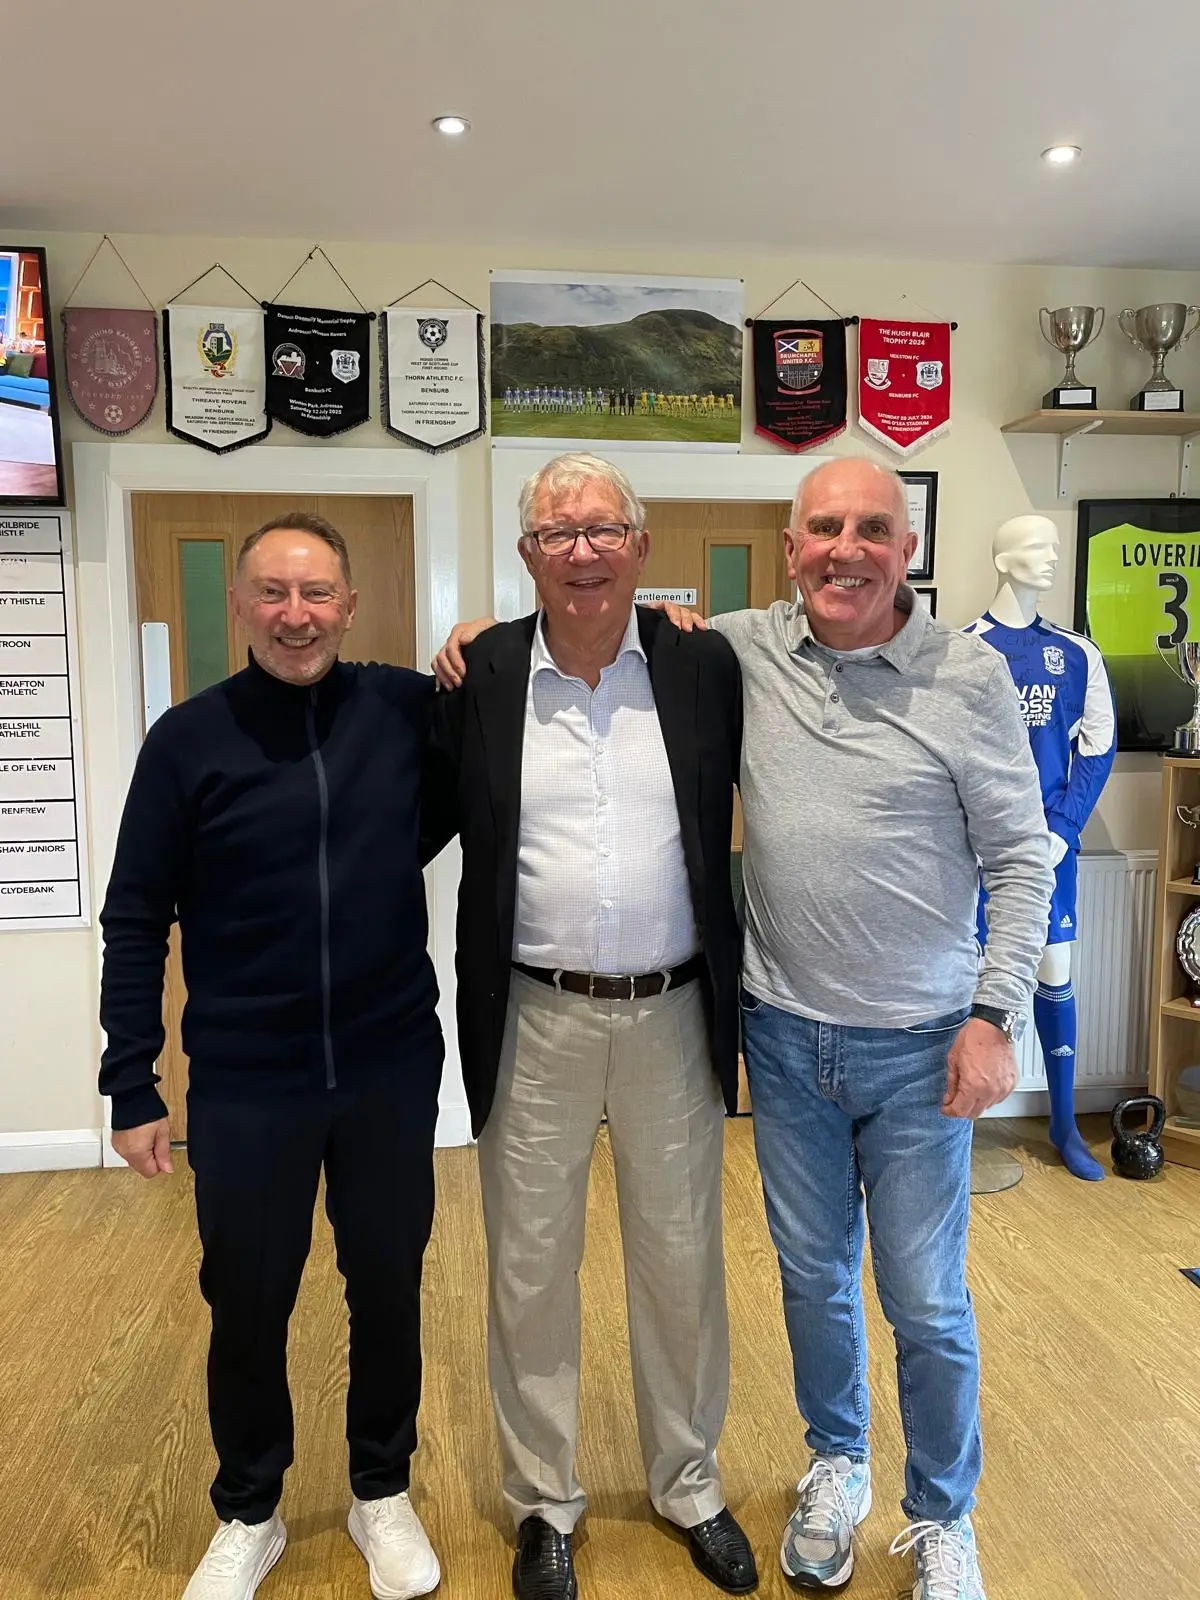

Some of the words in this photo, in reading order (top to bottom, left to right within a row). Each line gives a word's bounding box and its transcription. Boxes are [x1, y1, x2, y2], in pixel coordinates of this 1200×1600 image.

[290, 405, 311, 414] Saturday
[307, 413, 331, 421] Friendship
[877, 412, 900, 420] SATURDAY
[0, 521, 40, 529] KILBRIDE
[1122, 543, 1200, 567] LOVERI
[9, 597, 46, 605] THISTLE
[1158, 572, 1188, 649] 3
[1014, 684, 1056, 700] VAN
[0, 730, 40, 738] ATHLETIC
[11, 764, 24, 772] OF
[1, 807, 46, 815] RENFREW
[0, 886, 55, 895] CLYDEBANK
